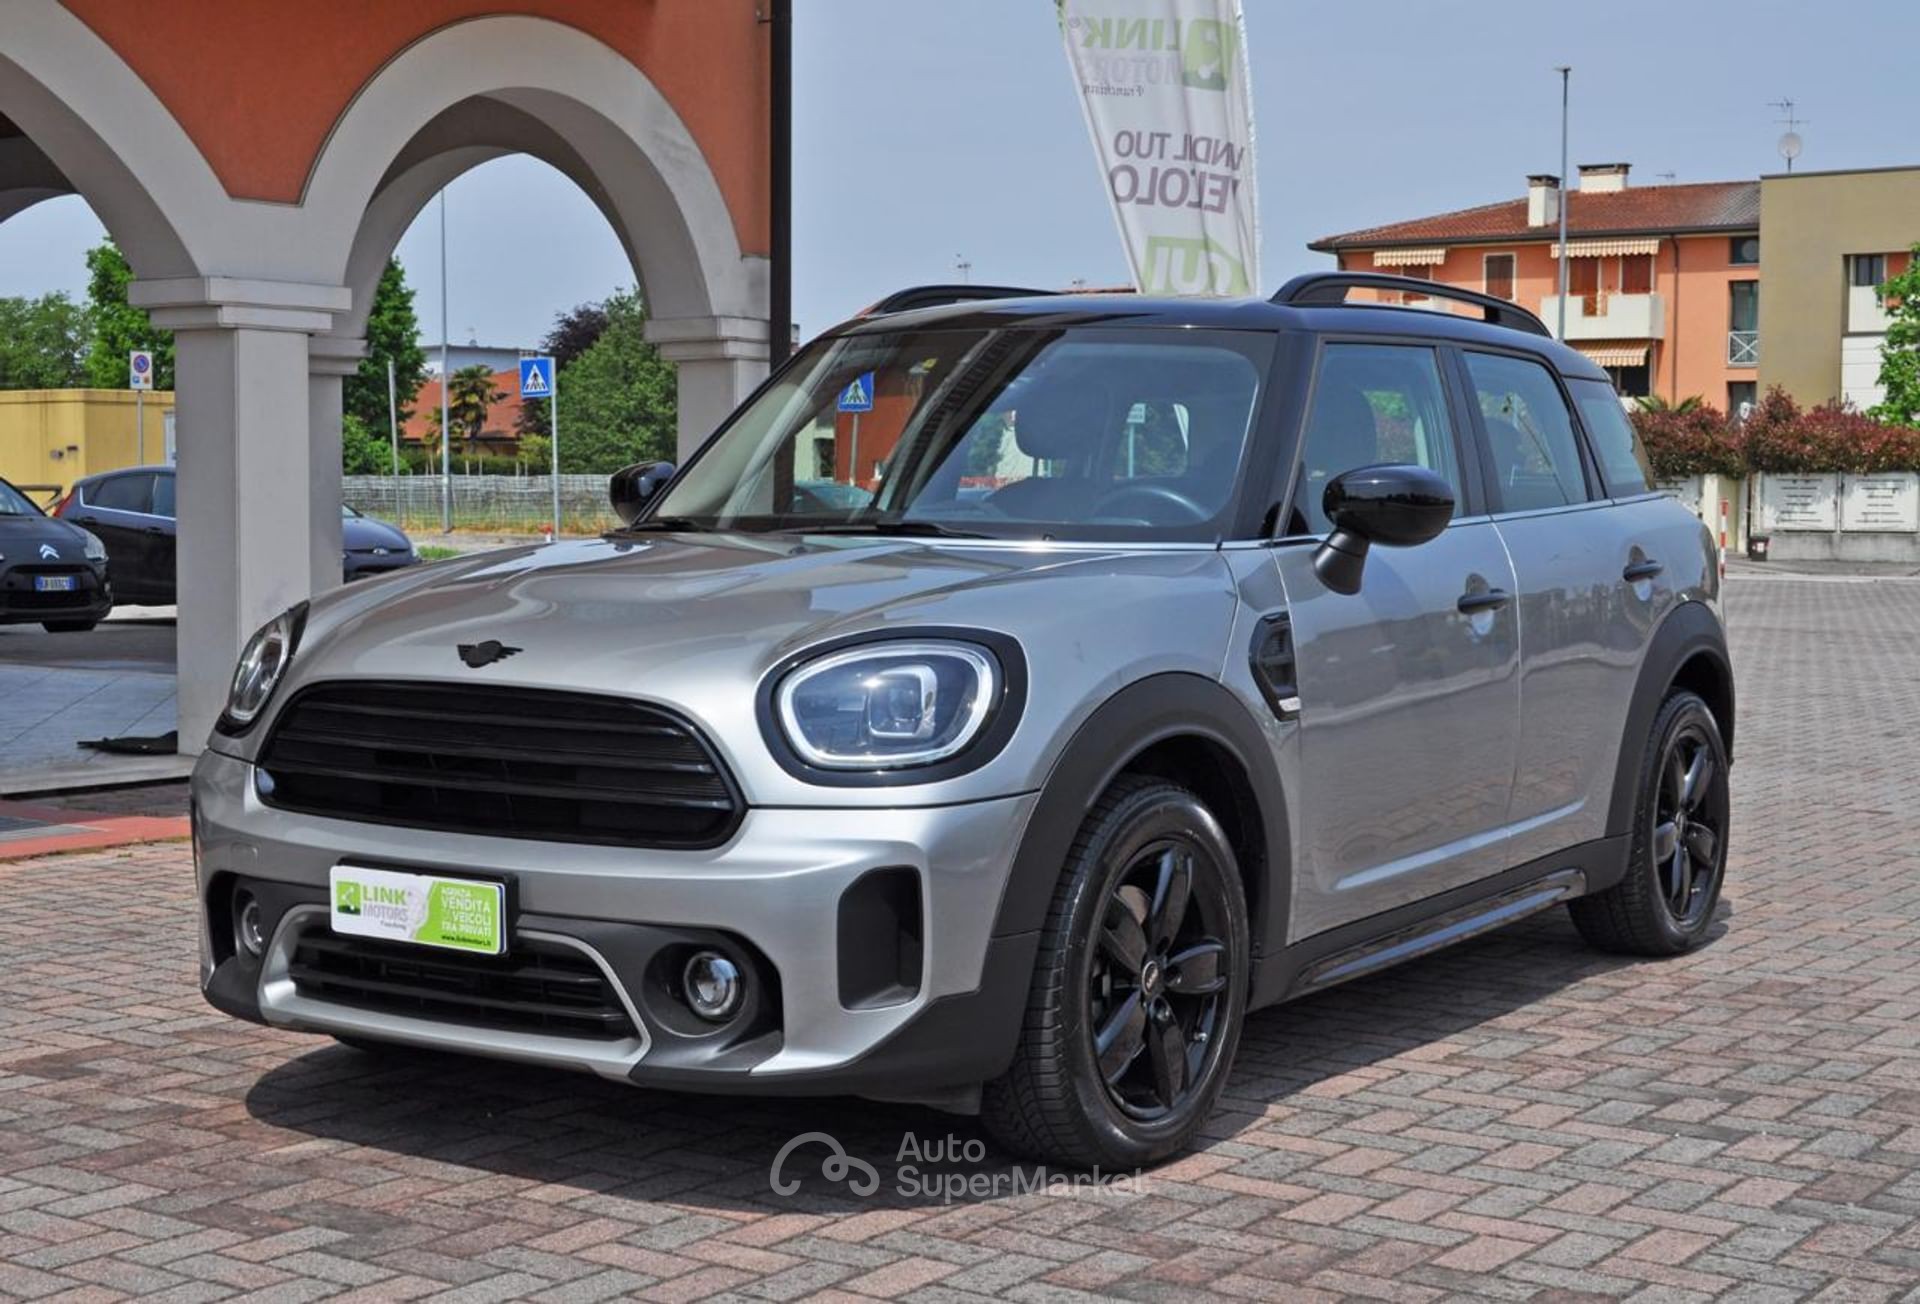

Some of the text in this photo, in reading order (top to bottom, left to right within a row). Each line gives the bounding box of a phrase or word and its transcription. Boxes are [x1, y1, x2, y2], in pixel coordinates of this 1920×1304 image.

[362, 885, 406, 906] LINK
[441, 894, 490, 913] VENDITA
[363, 903, 409, 922] MOTORS
